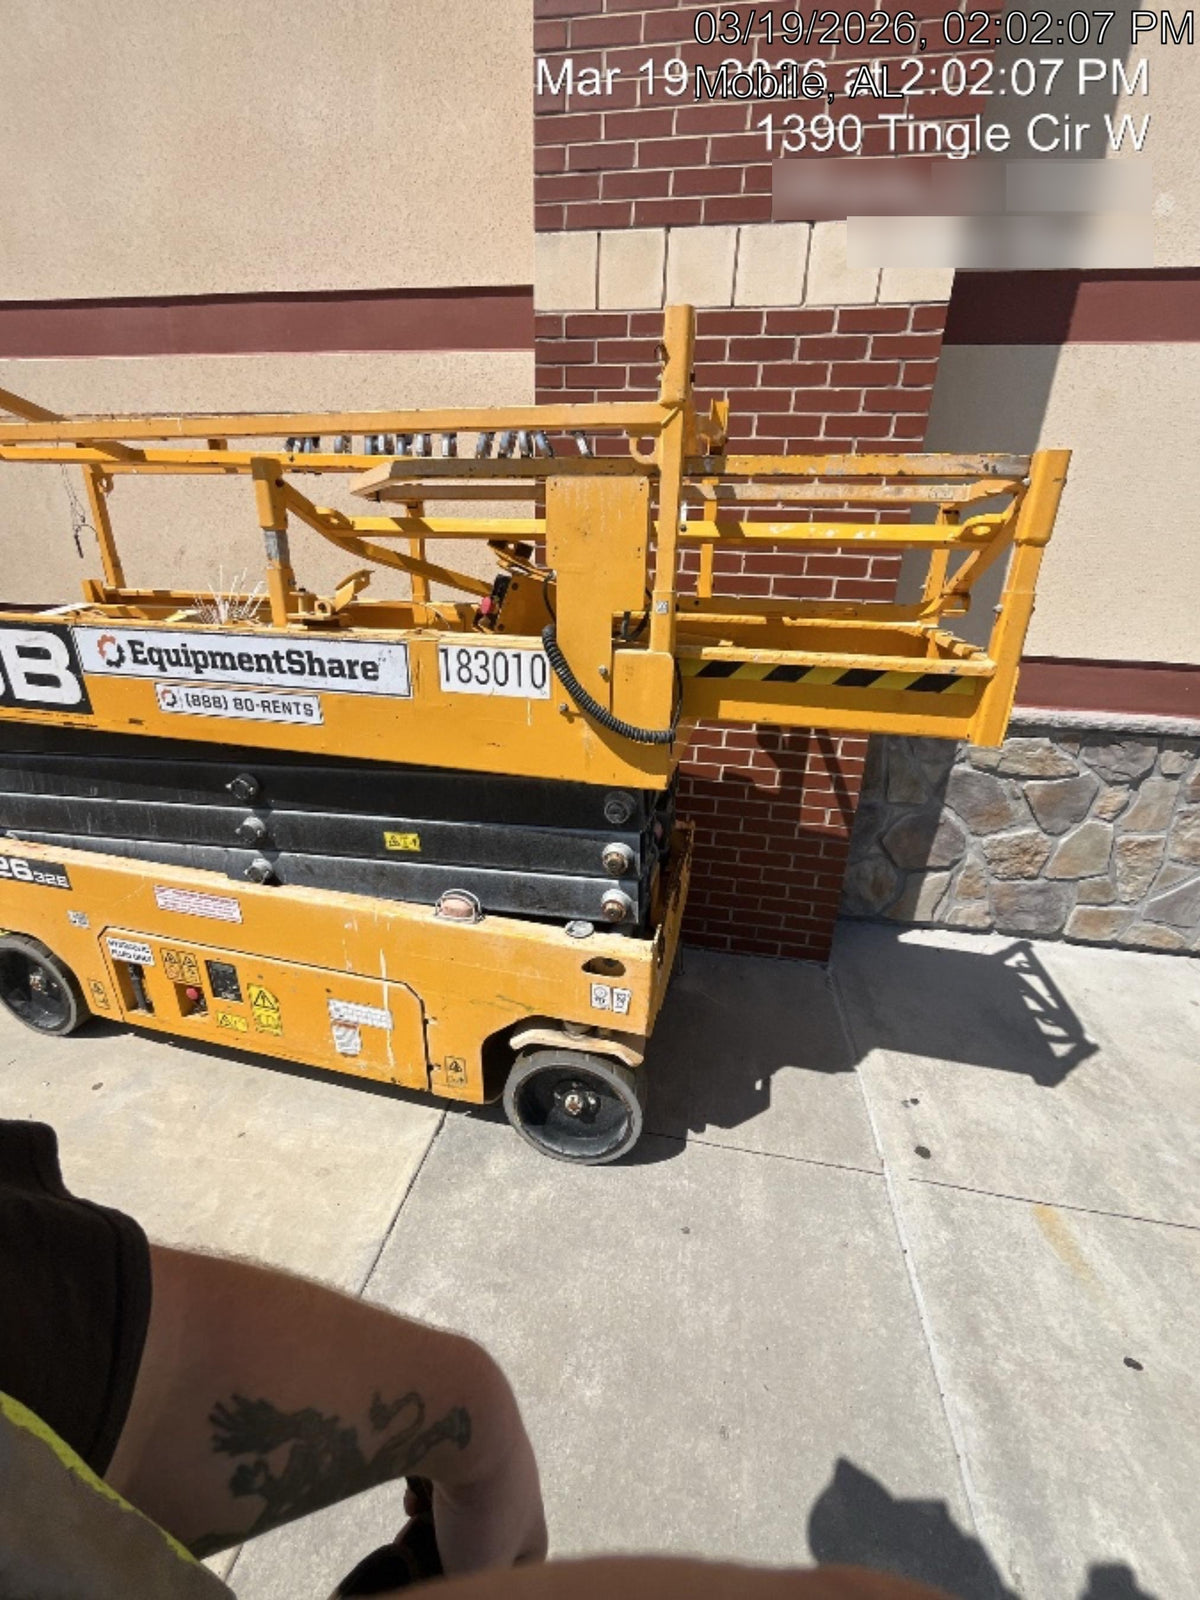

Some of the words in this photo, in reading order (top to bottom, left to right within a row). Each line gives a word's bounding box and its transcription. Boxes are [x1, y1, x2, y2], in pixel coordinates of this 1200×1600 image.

[0, 627, 82, 705] B
[127, 639, 380, 682] EquipmentShare
[439, 647, 547, 689] 183010
[185, 693, 228, 711] (888)
[233, 697, 314, 718] 80-RENTS
